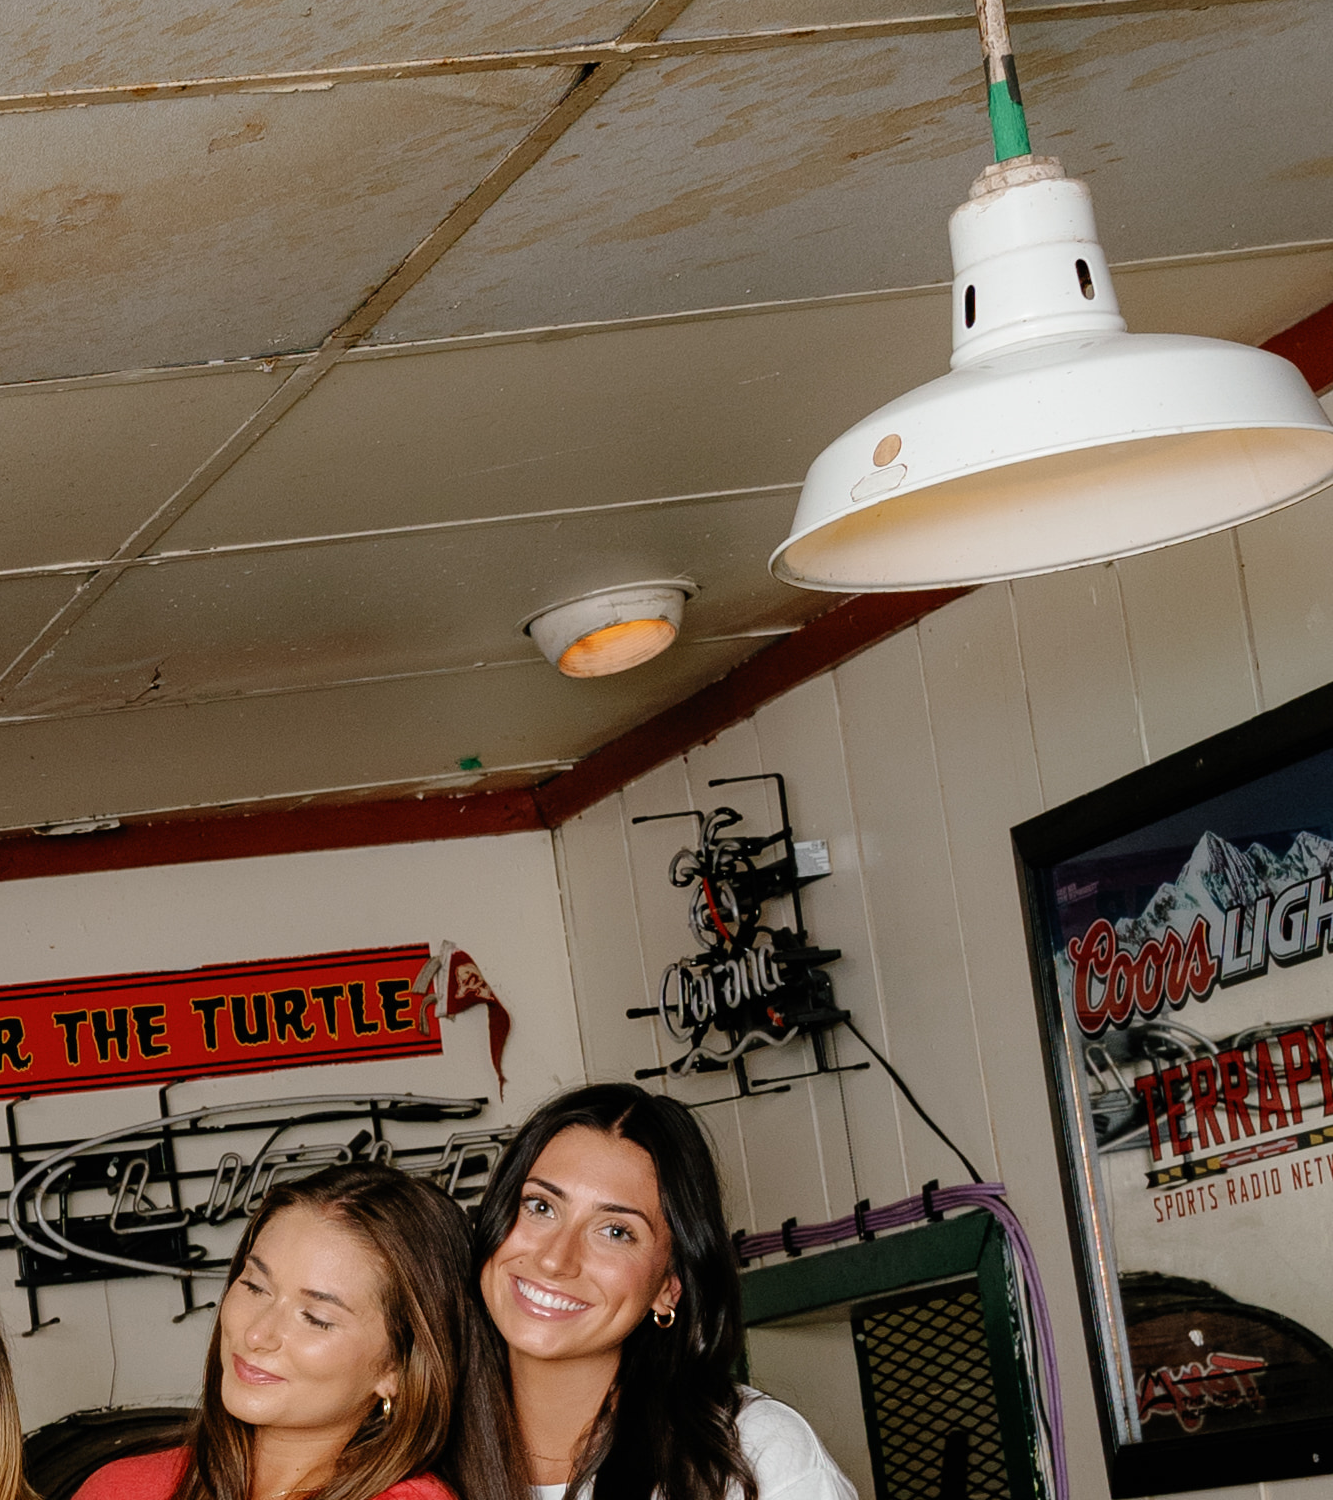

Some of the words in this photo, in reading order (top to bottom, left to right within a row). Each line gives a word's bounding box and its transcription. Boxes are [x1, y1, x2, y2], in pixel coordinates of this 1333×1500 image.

[53, 1003, 172, 1067] THE
[190, 978, 415, 1053] TURTLE
[1068, 915, 1217, 1034] Coors
[1134, 1022, 1333, 1163] TERRAPI
[1153, 1183, 1219, 1223] SPORTS
[1226, 1167, 1282, 1207] RADIO
